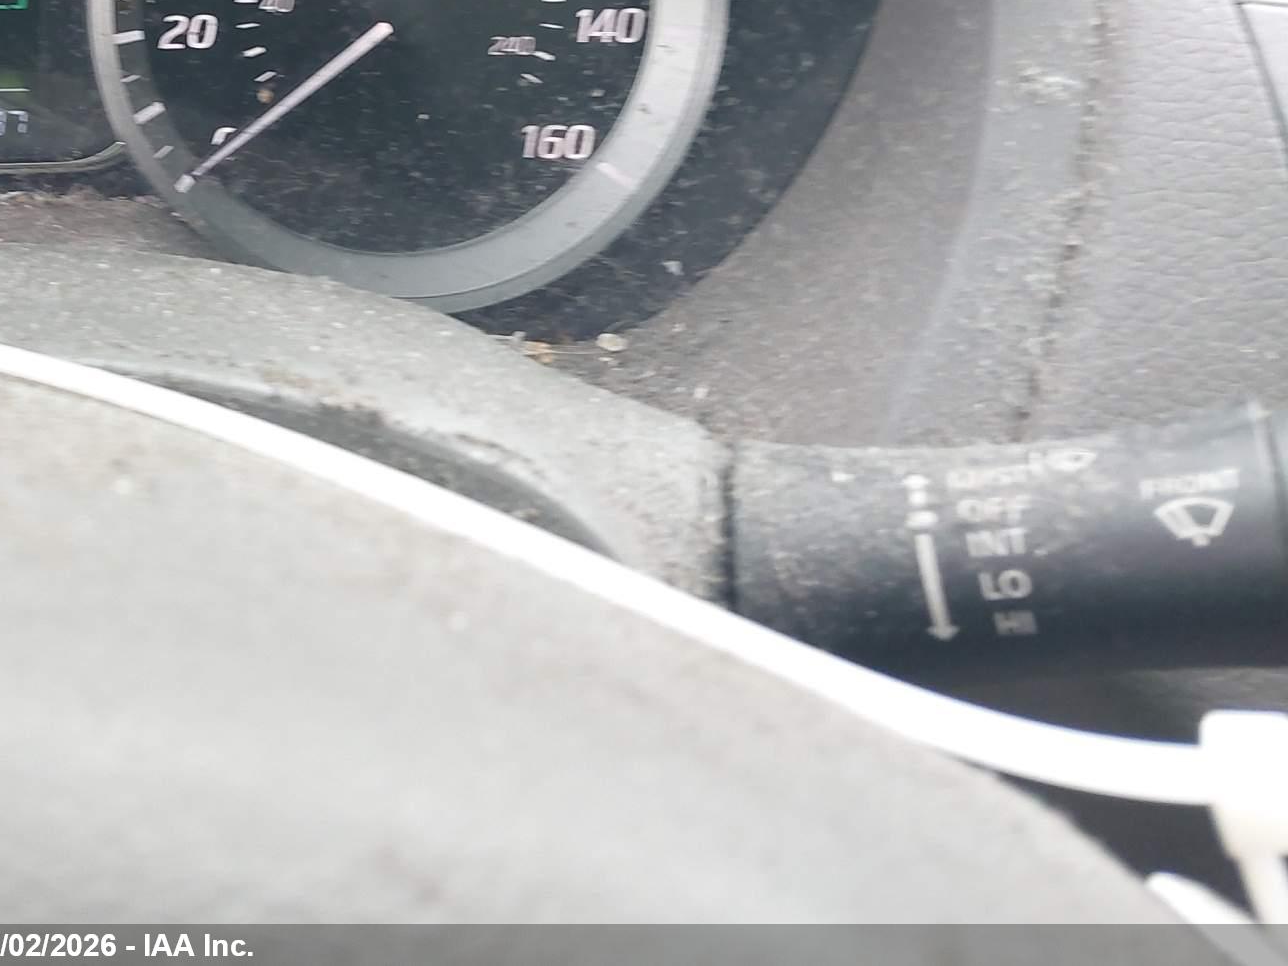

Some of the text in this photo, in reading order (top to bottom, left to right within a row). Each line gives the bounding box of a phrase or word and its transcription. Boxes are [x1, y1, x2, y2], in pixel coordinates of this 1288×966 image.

[157, 14, 219, 50] 20
[574, 8, 648, 44] 140
[488, 36, 537, 56] 240
[520, 125, 597, 161] 160
[977, 569, 1033, 601] LO
